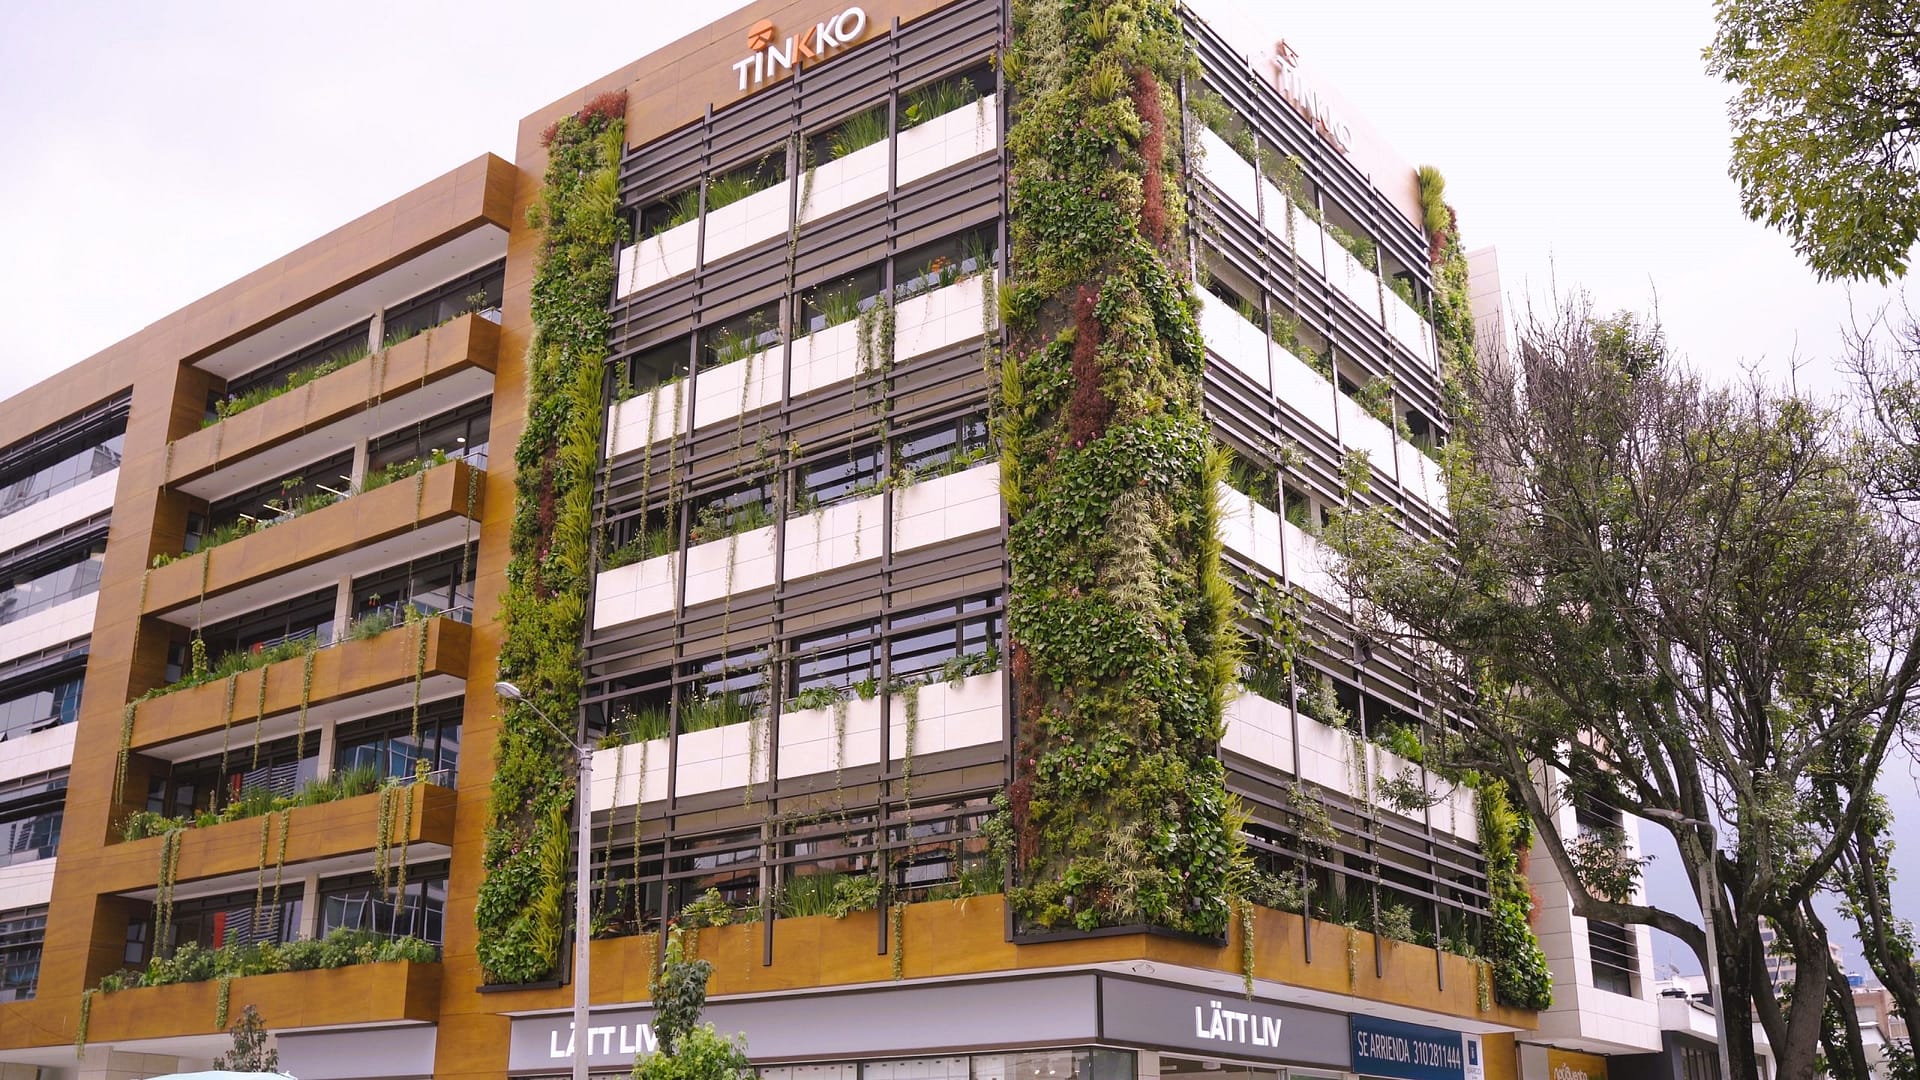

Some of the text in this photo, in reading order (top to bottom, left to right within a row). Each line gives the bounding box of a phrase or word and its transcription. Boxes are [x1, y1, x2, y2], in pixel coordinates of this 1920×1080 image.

[732, 6, 867, 91] TINKKO
[619, 1024, 660, 1054] LIV
[1195, 1000, 1282, 1048] LÄTT LIV
[1357, 1030, 1461, 1069] SE ARRIENDA 310 2811444
